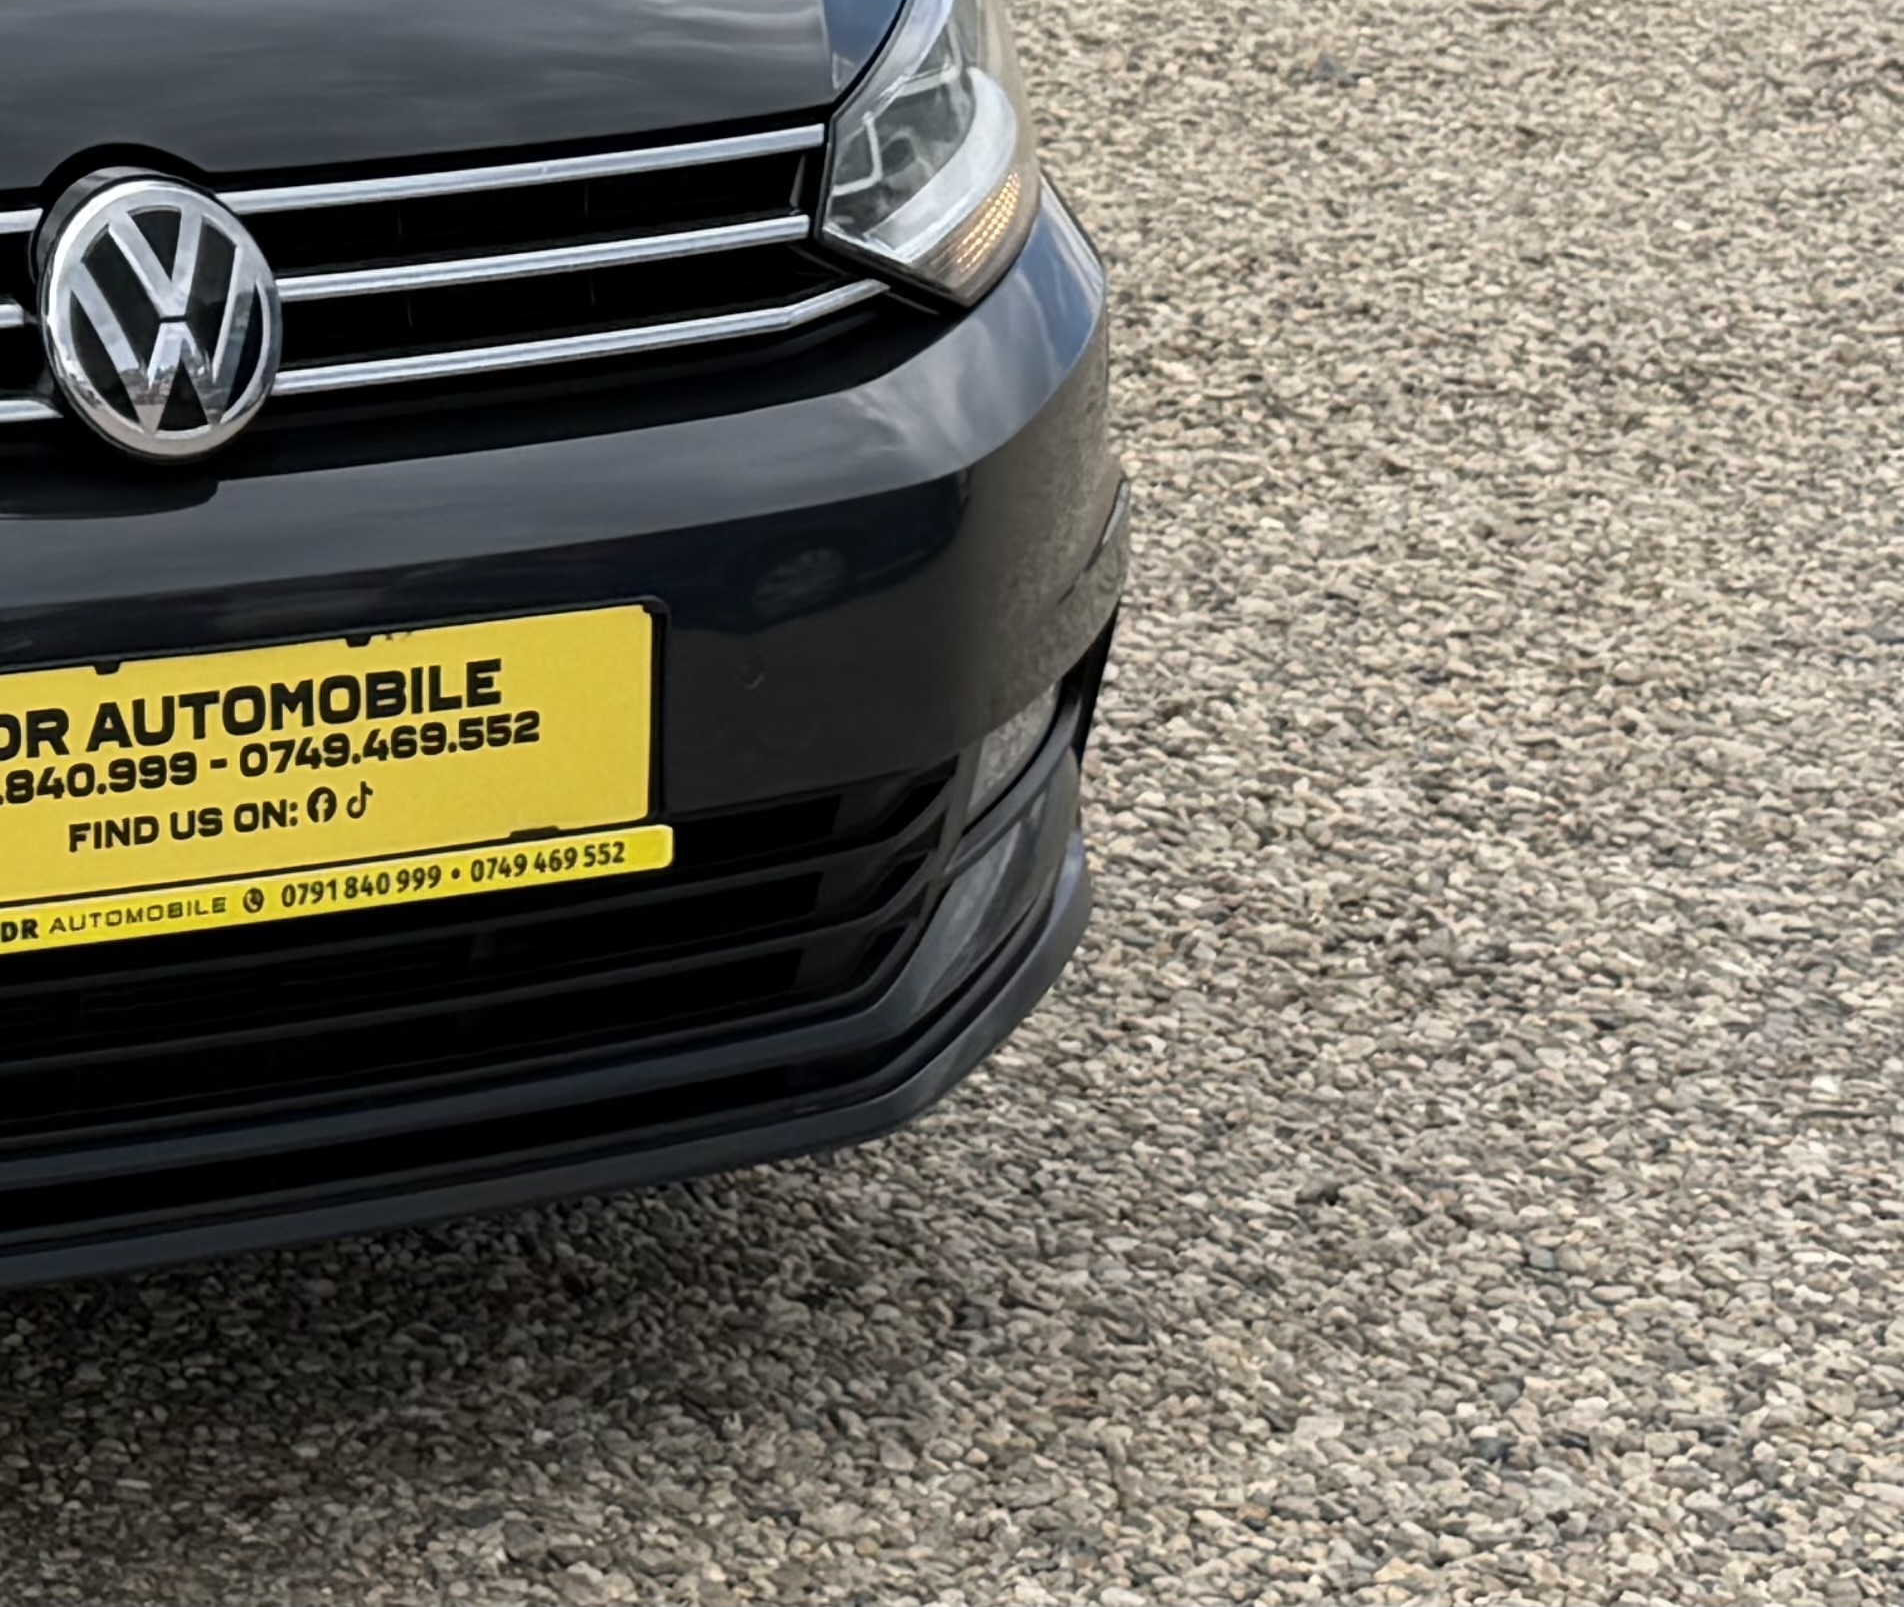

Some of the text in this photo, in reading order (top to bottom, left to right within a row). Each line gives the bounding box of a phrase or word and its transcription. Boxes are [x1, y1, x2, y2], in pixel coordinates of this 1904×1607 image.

[85, 657, 503, 753] AUTOMOBILE
[210, 757, 228, 770] -
[239, 710, 541, 778] 0749.469.552
[68, 799, 299, 853] FIND US ON:
[48, 895, 228, 935] AUTOMOBILE
[281, 878, 338, 909] 0791
[344, 871, 391, 901] 840
[396, 864, 443, 894] 999
[470, 852, 529, 883] 0749
[534, 845, 579, 875] 469
[583, 840, 626, 869] 552
